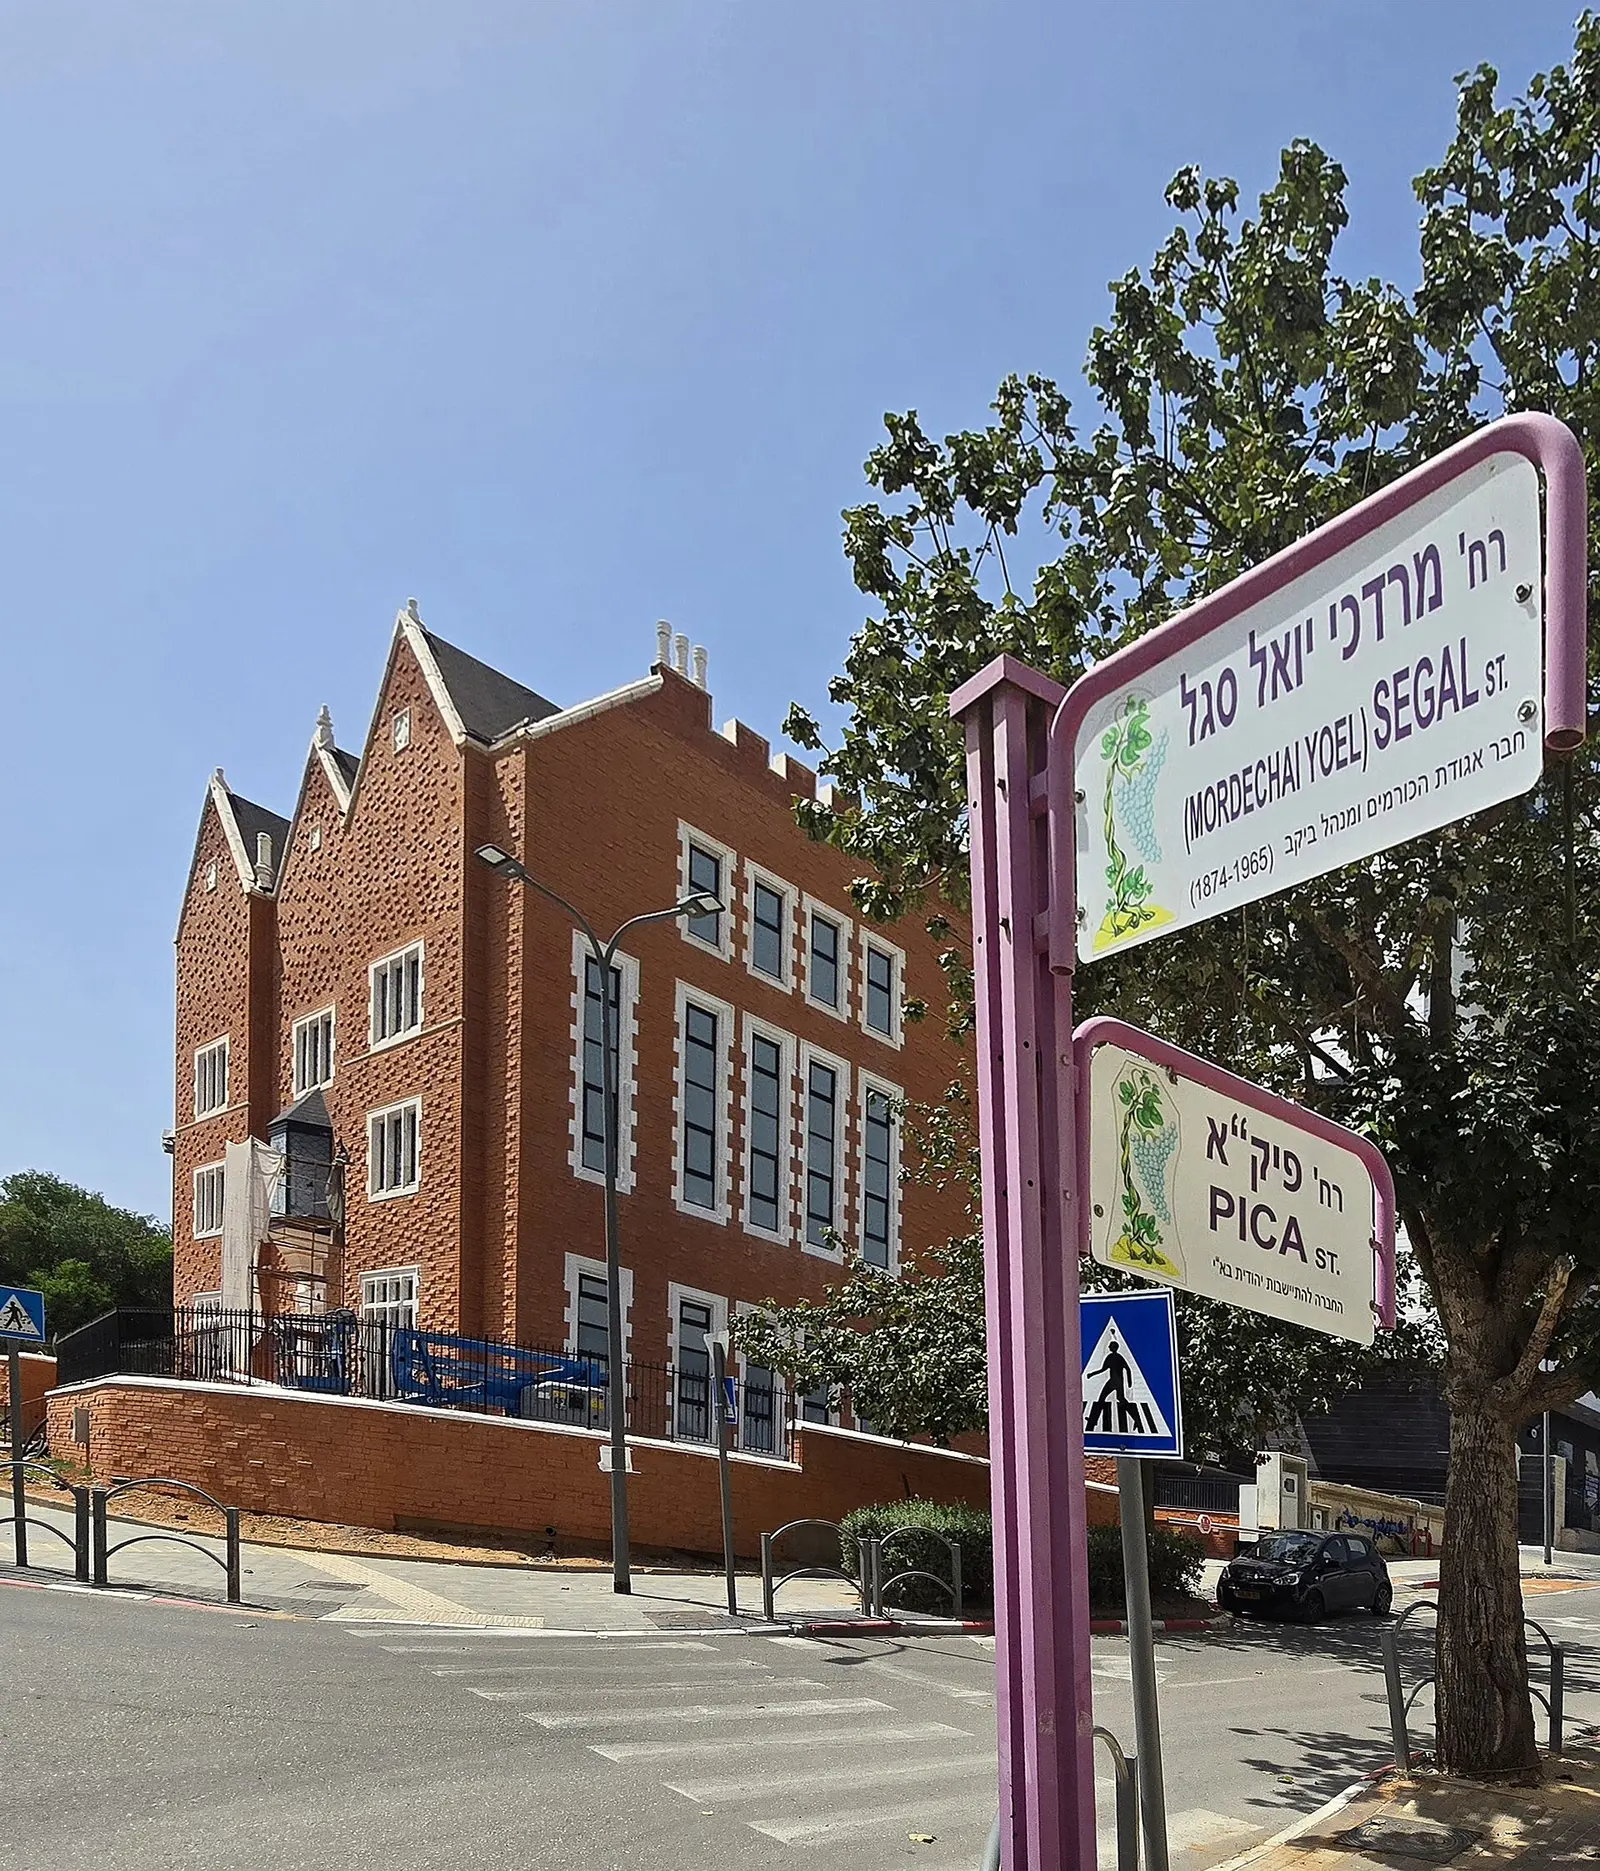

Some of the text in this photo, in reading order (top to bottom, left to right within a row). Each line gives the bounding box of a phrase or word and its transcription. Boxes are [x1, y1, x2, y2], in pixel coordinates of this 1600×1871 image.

[1180, 528, 1507, 747] רח' מרדכי יואל סגל
[1184, 637, 1509, 856] (MORDECHAI YOEL) SEGAL ST.
[1190, 731, 1525, 909] חבר אגודת הכורמים ומנהל ביקב (1874-1965)
[1313, 1166, 1344, 1212] רח'
[1209, 1185, 1341, 1276] PICA ST.
[1235, 1267, 1264, 1288] יהודית
[1265, 1277, 1313, 1305] להתיישבות
[1314, 1293, 1344, 1314] החברה
